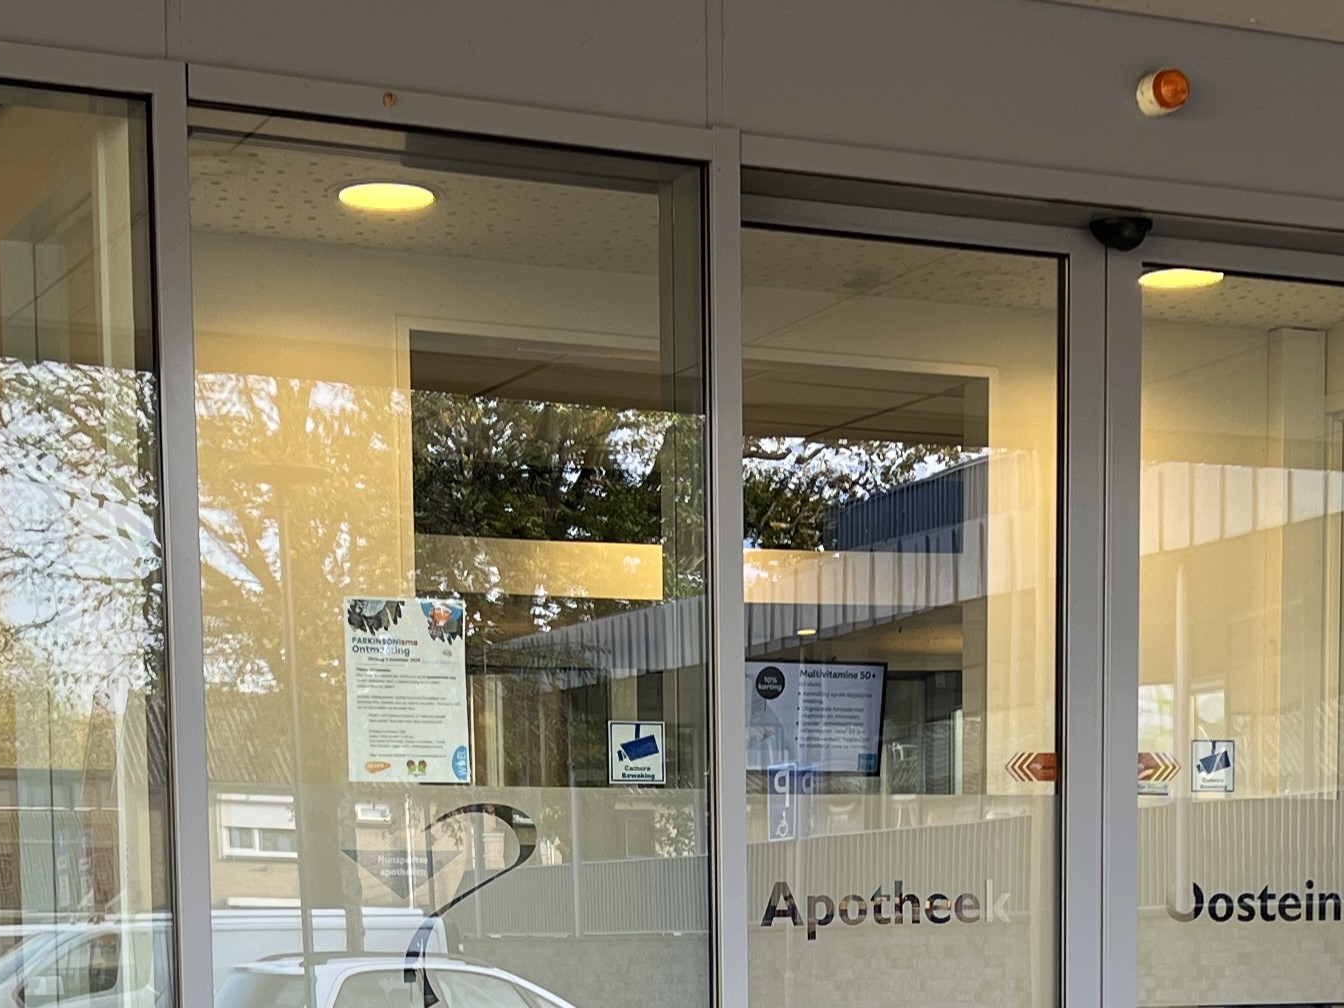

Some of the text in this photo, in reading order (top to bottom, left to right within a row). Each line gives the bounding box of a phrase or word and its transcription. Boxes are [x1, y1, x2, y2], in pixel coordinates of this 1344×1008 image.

[352, 645, 410, 657] Ontmting
[763, 675, 777, 684] 10%
[799, 670, 876, 680] Multivitamine 50+
[758, 683, 782, 692] korting
[622, 772, 655, 780] Bewaking
[380, 866, 427, 878] apothen
[760, 879, 1011, 941] Apotheek
